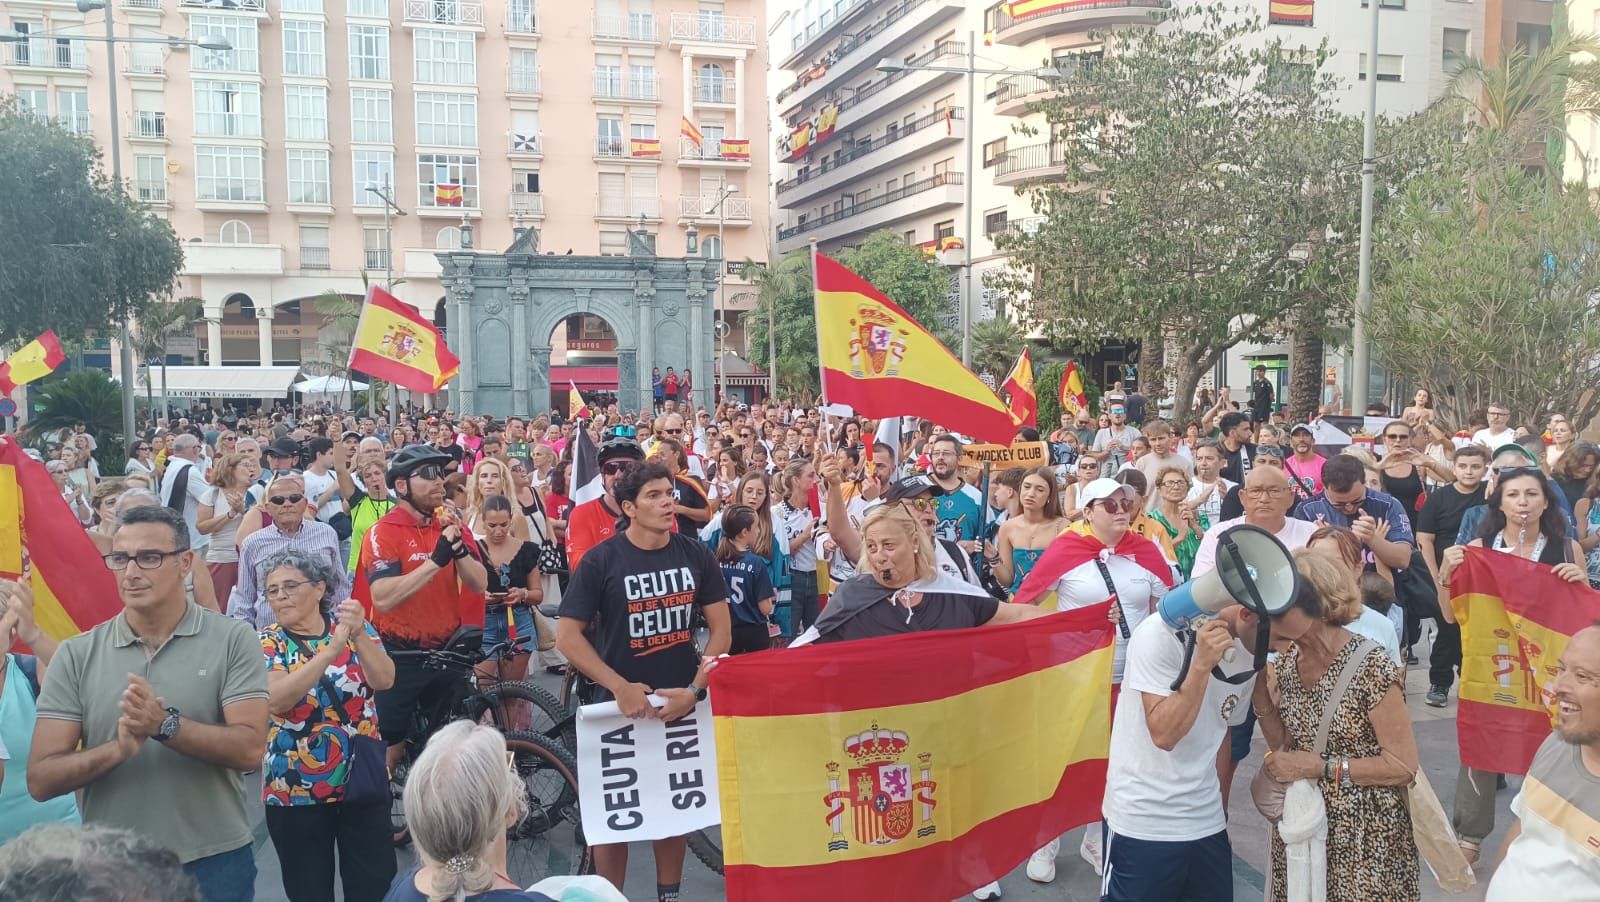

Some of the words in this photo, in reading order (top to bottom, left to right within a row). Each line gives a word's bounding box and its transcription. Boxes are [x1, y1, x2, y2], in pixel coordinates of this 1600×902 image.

[976, 448, 1014, 462] HOCKEY
[1017, 447, 1041, 460] CLUB
[624, 567, 696, 600] CEUTA
[628, 602, 643, 613] NO
[646, 600, 658, 611] SE
[662, 593, 694, 608] VENDE
[630, 640, 644, 649] SE
[601, 723, 643, 831] CEUTA
[669, 769, 707, 810] SE
